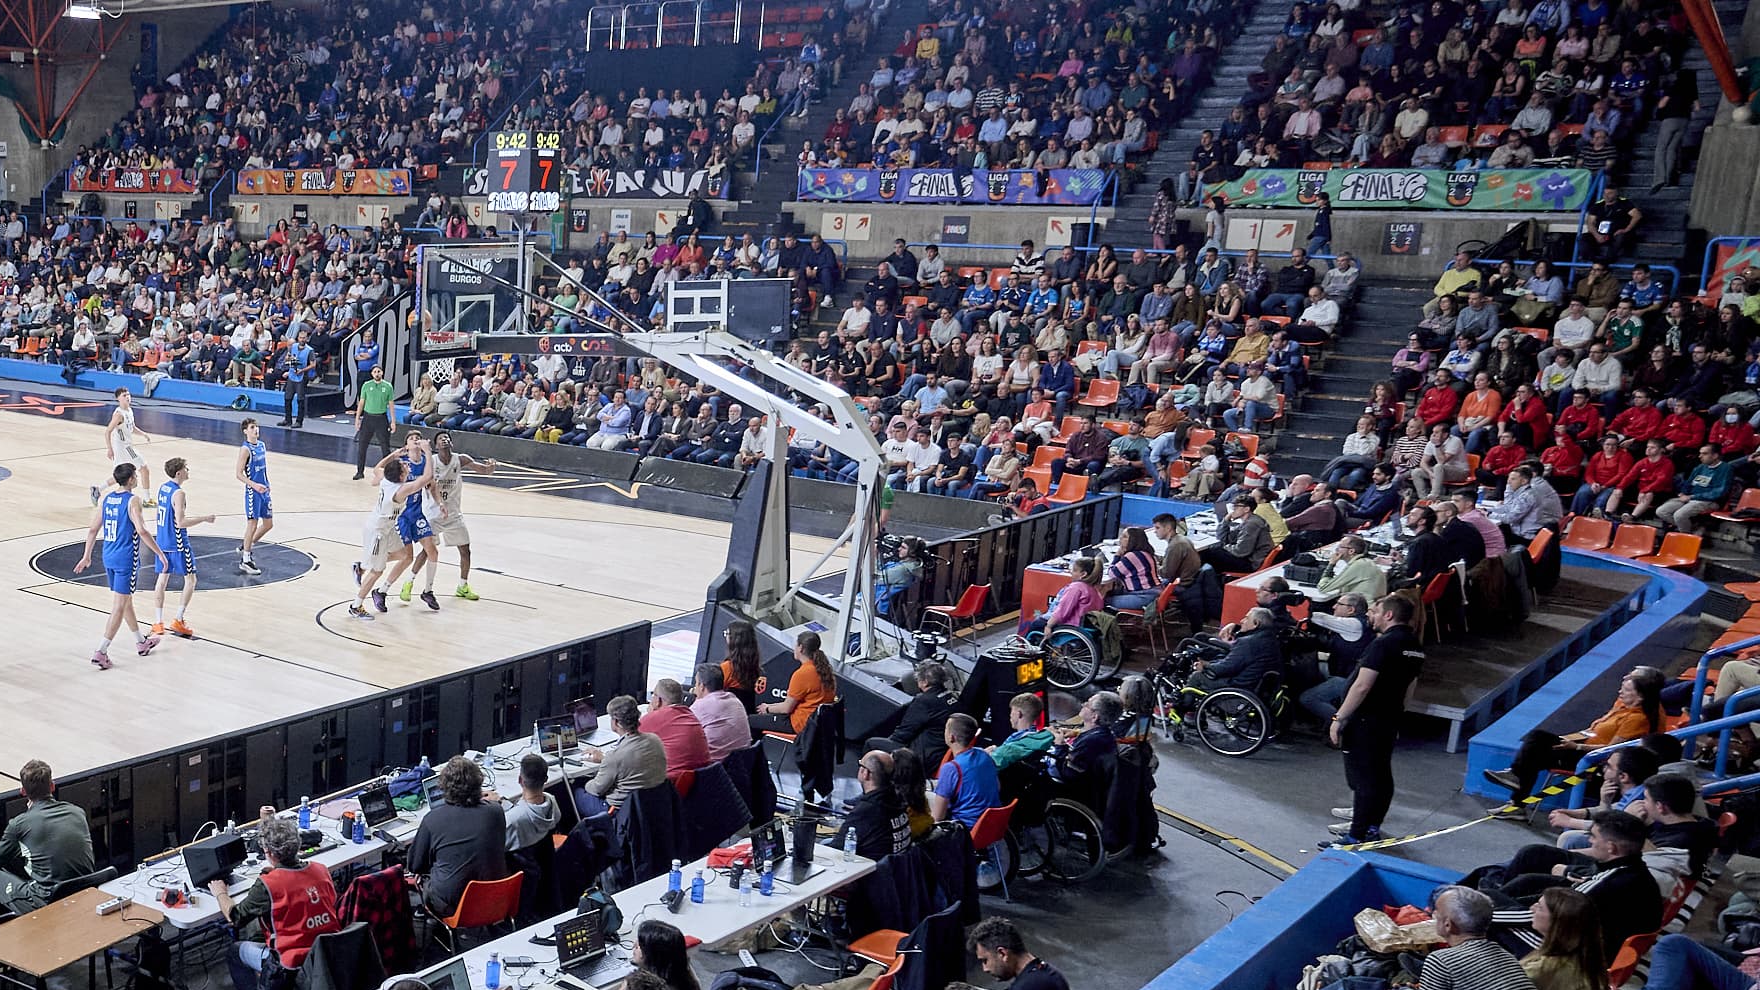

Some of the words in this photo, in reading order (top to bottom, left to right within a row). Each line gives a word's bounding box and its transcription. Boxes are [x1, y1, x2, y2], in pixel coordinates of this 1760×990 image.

[496, 133, 527, 149] 9:42
[536, 132, 560, 149] 9:42
[500, 160, 518, 190] 7
[539, 160, 553, 190] 7
[1299, 173, 1324, 182] LIGA
[1447, 174, 1475, 183] LIGA
[474, 206, 480, 217] 5
[833, 216, 843, 229] 3
[1390, 225, 1414, 233] LIGA
[1249, 223, 1257, 239] 1
[449, 274, 482, 285] BURGOS
[553, 342, 573, 352] acb
[104, 519, 118, 542] 59
[1020, 658, 1044, 683] 9:42
[772, 687, 789, 699] ac
[306, 912, 330, 929] ORG
